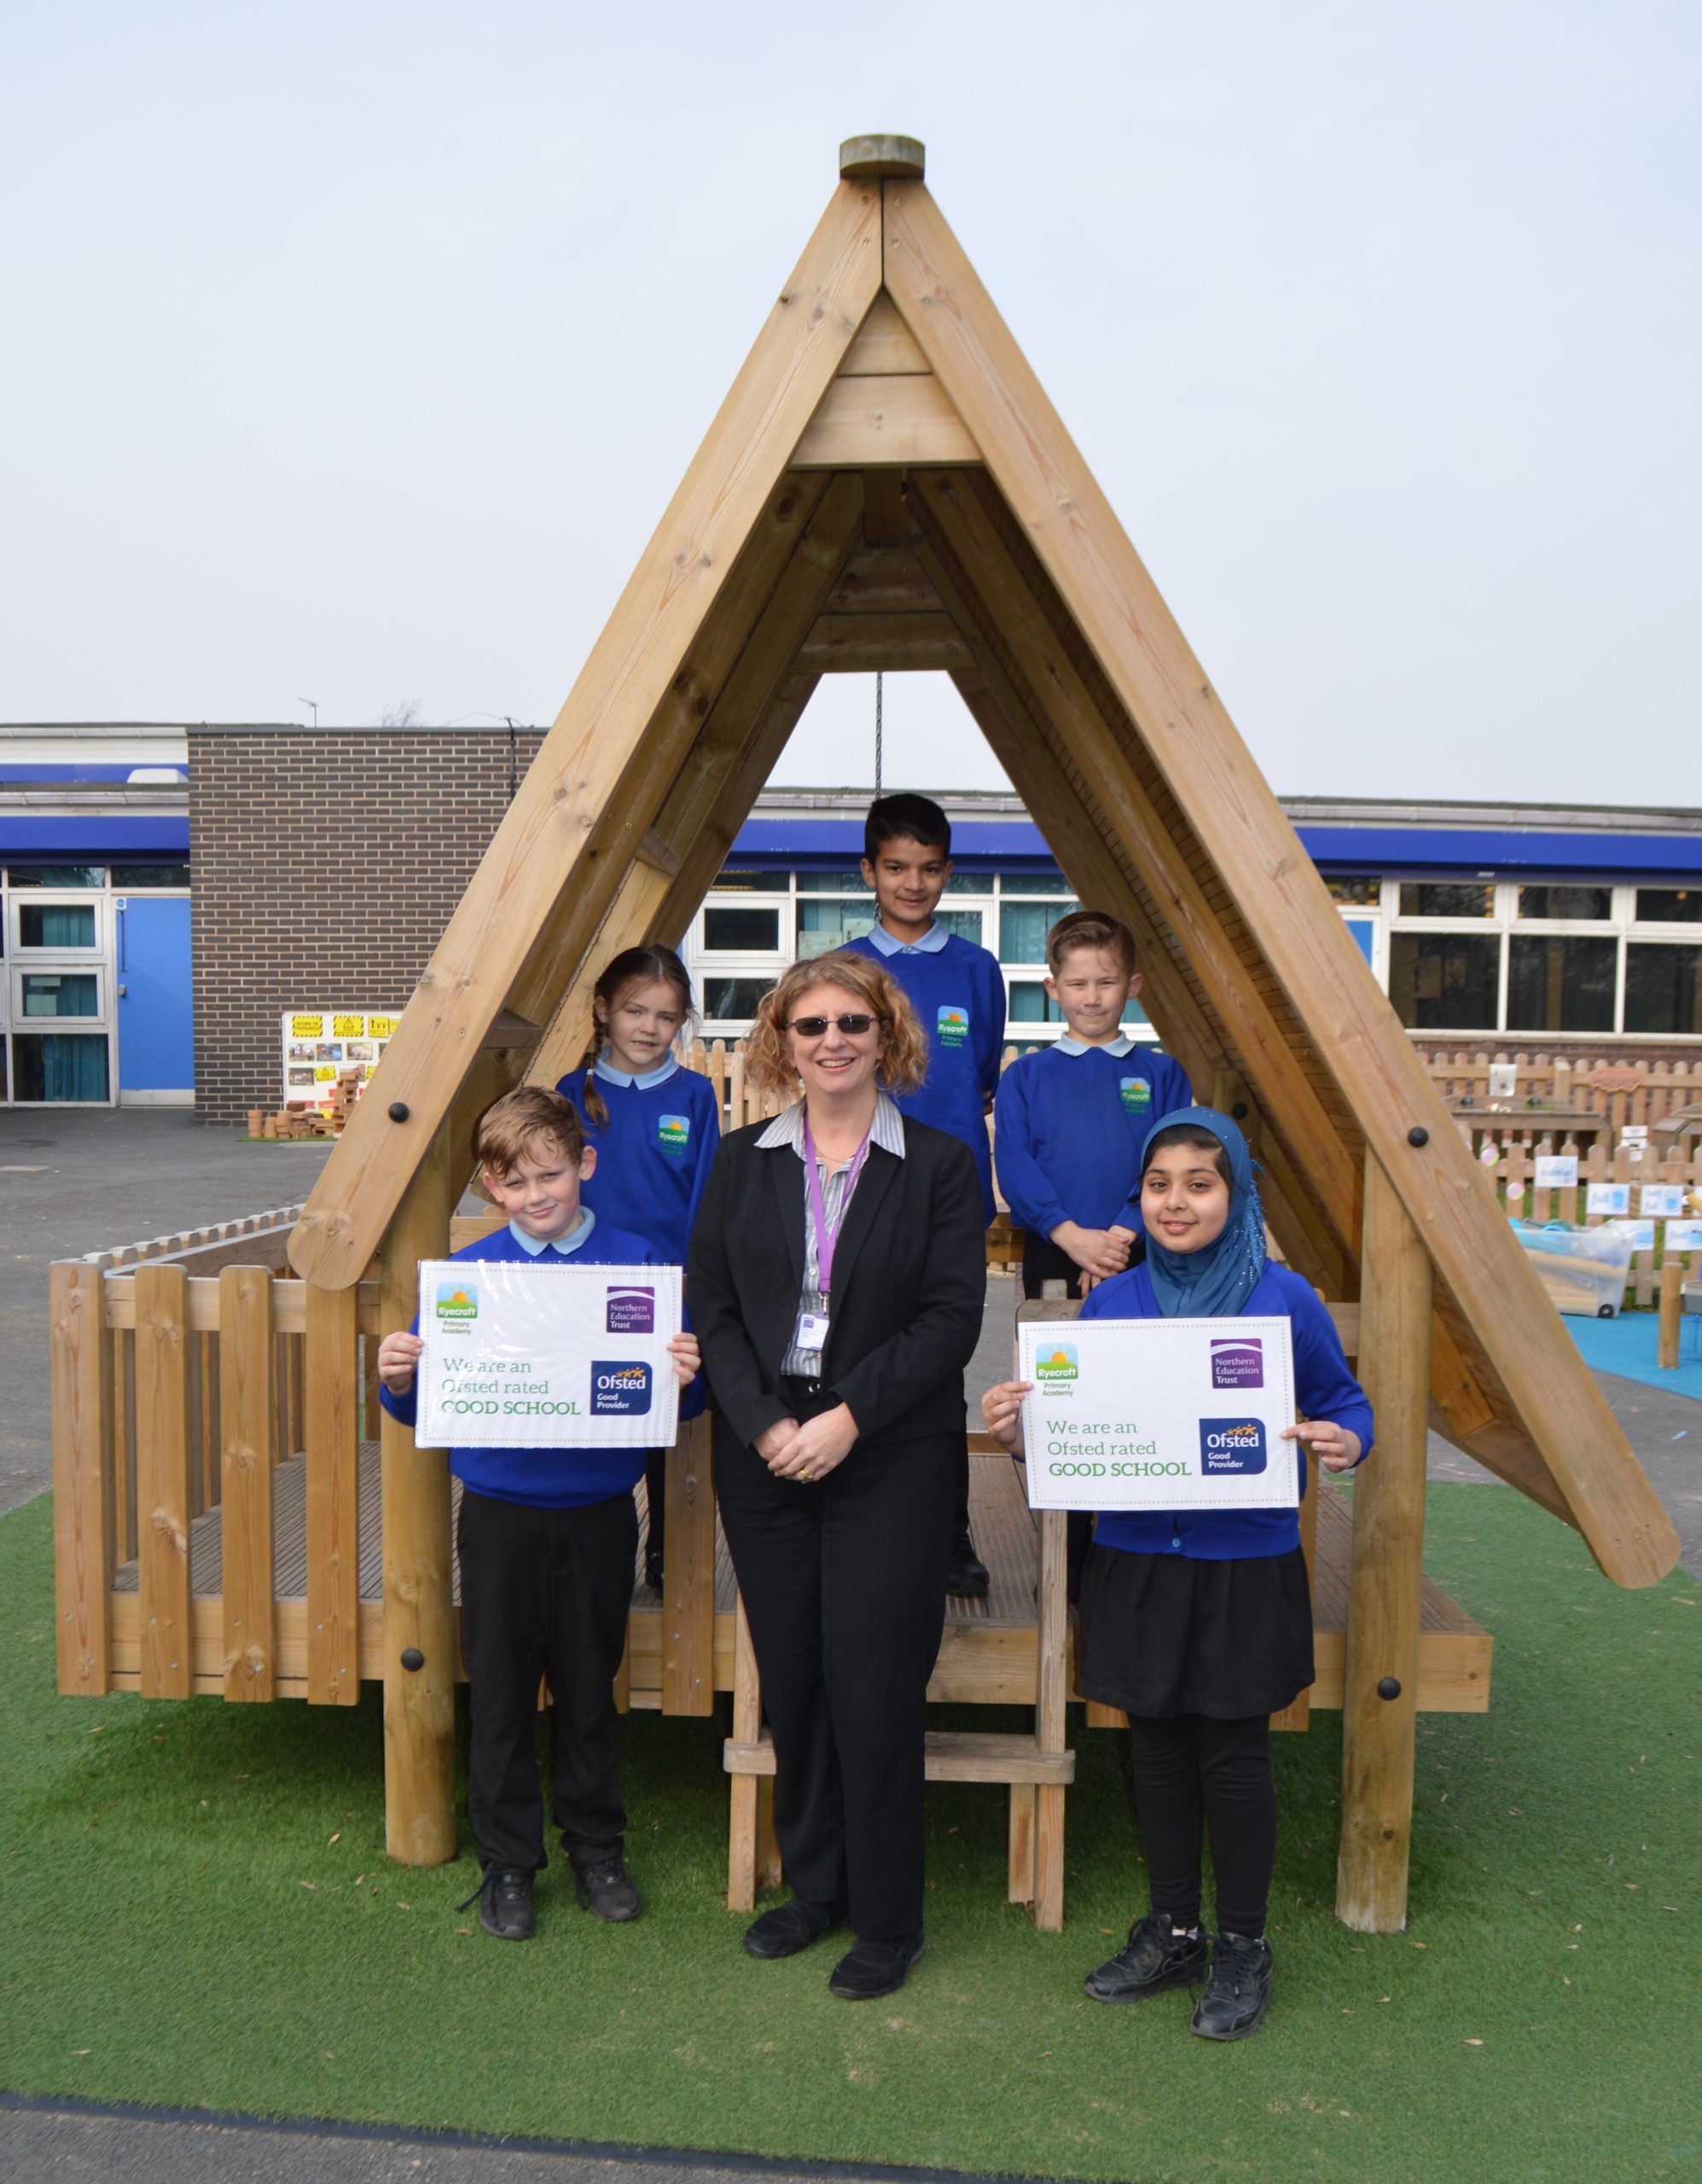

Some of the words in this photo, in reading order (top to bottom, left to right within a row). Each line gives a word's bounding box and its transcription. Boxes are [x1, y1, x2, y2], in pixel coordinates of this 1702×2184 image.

[938, 1024, 967, 1033] Ryecroft
[438, 1306, 478, 1318] Ryecroft
[610, 1304, 648, 1312] Northern
[610, 1312, 651, 1321] Education
[444, 1321, 470, 1329] Primary
[610, 1321, 630, 1329] Trust
[441, 1327, 472, 1336] Academy
[443, 1358, 473, 1373] We
[478, 1362, 506, 1373] are
[510, 1362, 532, 1373] an
[1215, 1357, 1255, 1367] Northern
[1038, 1367, 1078, 1379] Ryecroft
[1216, 1366, 1259, 1375] Education
[597, 1374, 646, 1390] Ofsted
[1216, 1375, 1238, 1384] Trust
[504, 1380, 549, 1394] rated
[1043, 1382, 1071, 1391] Primary
[1043, 1389, 1073, 1397] Academy
[503, 1401, 581, 1415] SCHOOL
[597, 1401, 630, 1409] Provider
[1047, 1420, 1078, 1434] We
[1083, 1422, 1111, 1434] are
[1116, 1422, 1137, 1434] an
[1207, 1432, 1260, 1448] Ofsted
[1048, 1440, 1105, 1455] Ofsted
[1110, 1440, 1157, 1455] rated
[1208, 1452, 1230, 1461] Good
[1049, 1462, 1106, 1476] GOOD
[1111, 1462, 1192, 1476] SCHOOL
[1208, 1460, 1244, 1469] Provider
